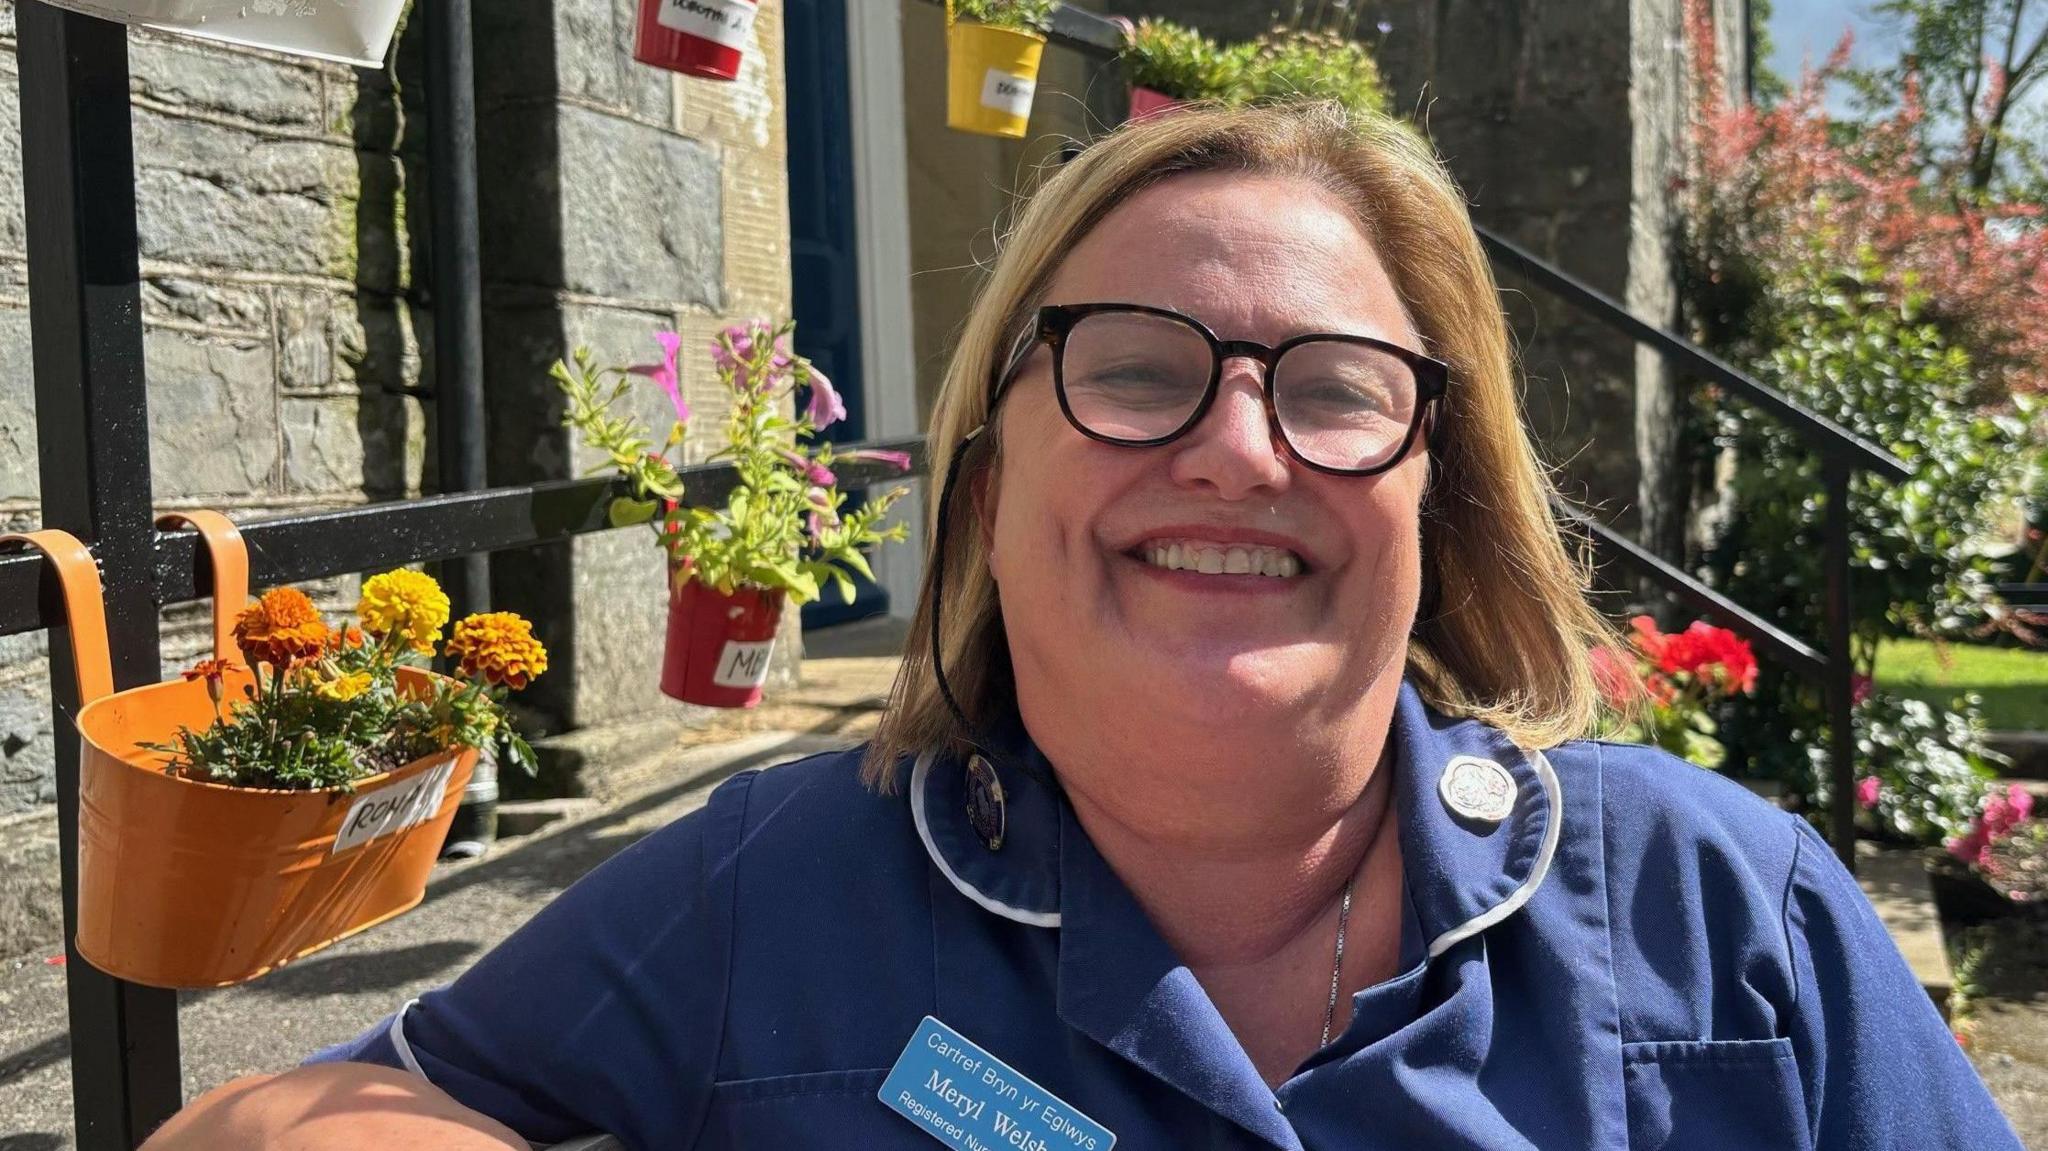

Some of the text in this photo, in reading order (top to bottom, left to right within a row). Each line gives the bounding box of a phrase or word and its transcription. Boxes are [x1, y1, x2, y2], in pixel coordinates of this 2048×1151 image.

[898, 1090, 964, 1140] Registered
[923, 1069, 986, 1121] Meryl
[928, 1032, 1097, 1151] Cartref Bryn yr Eglwys
